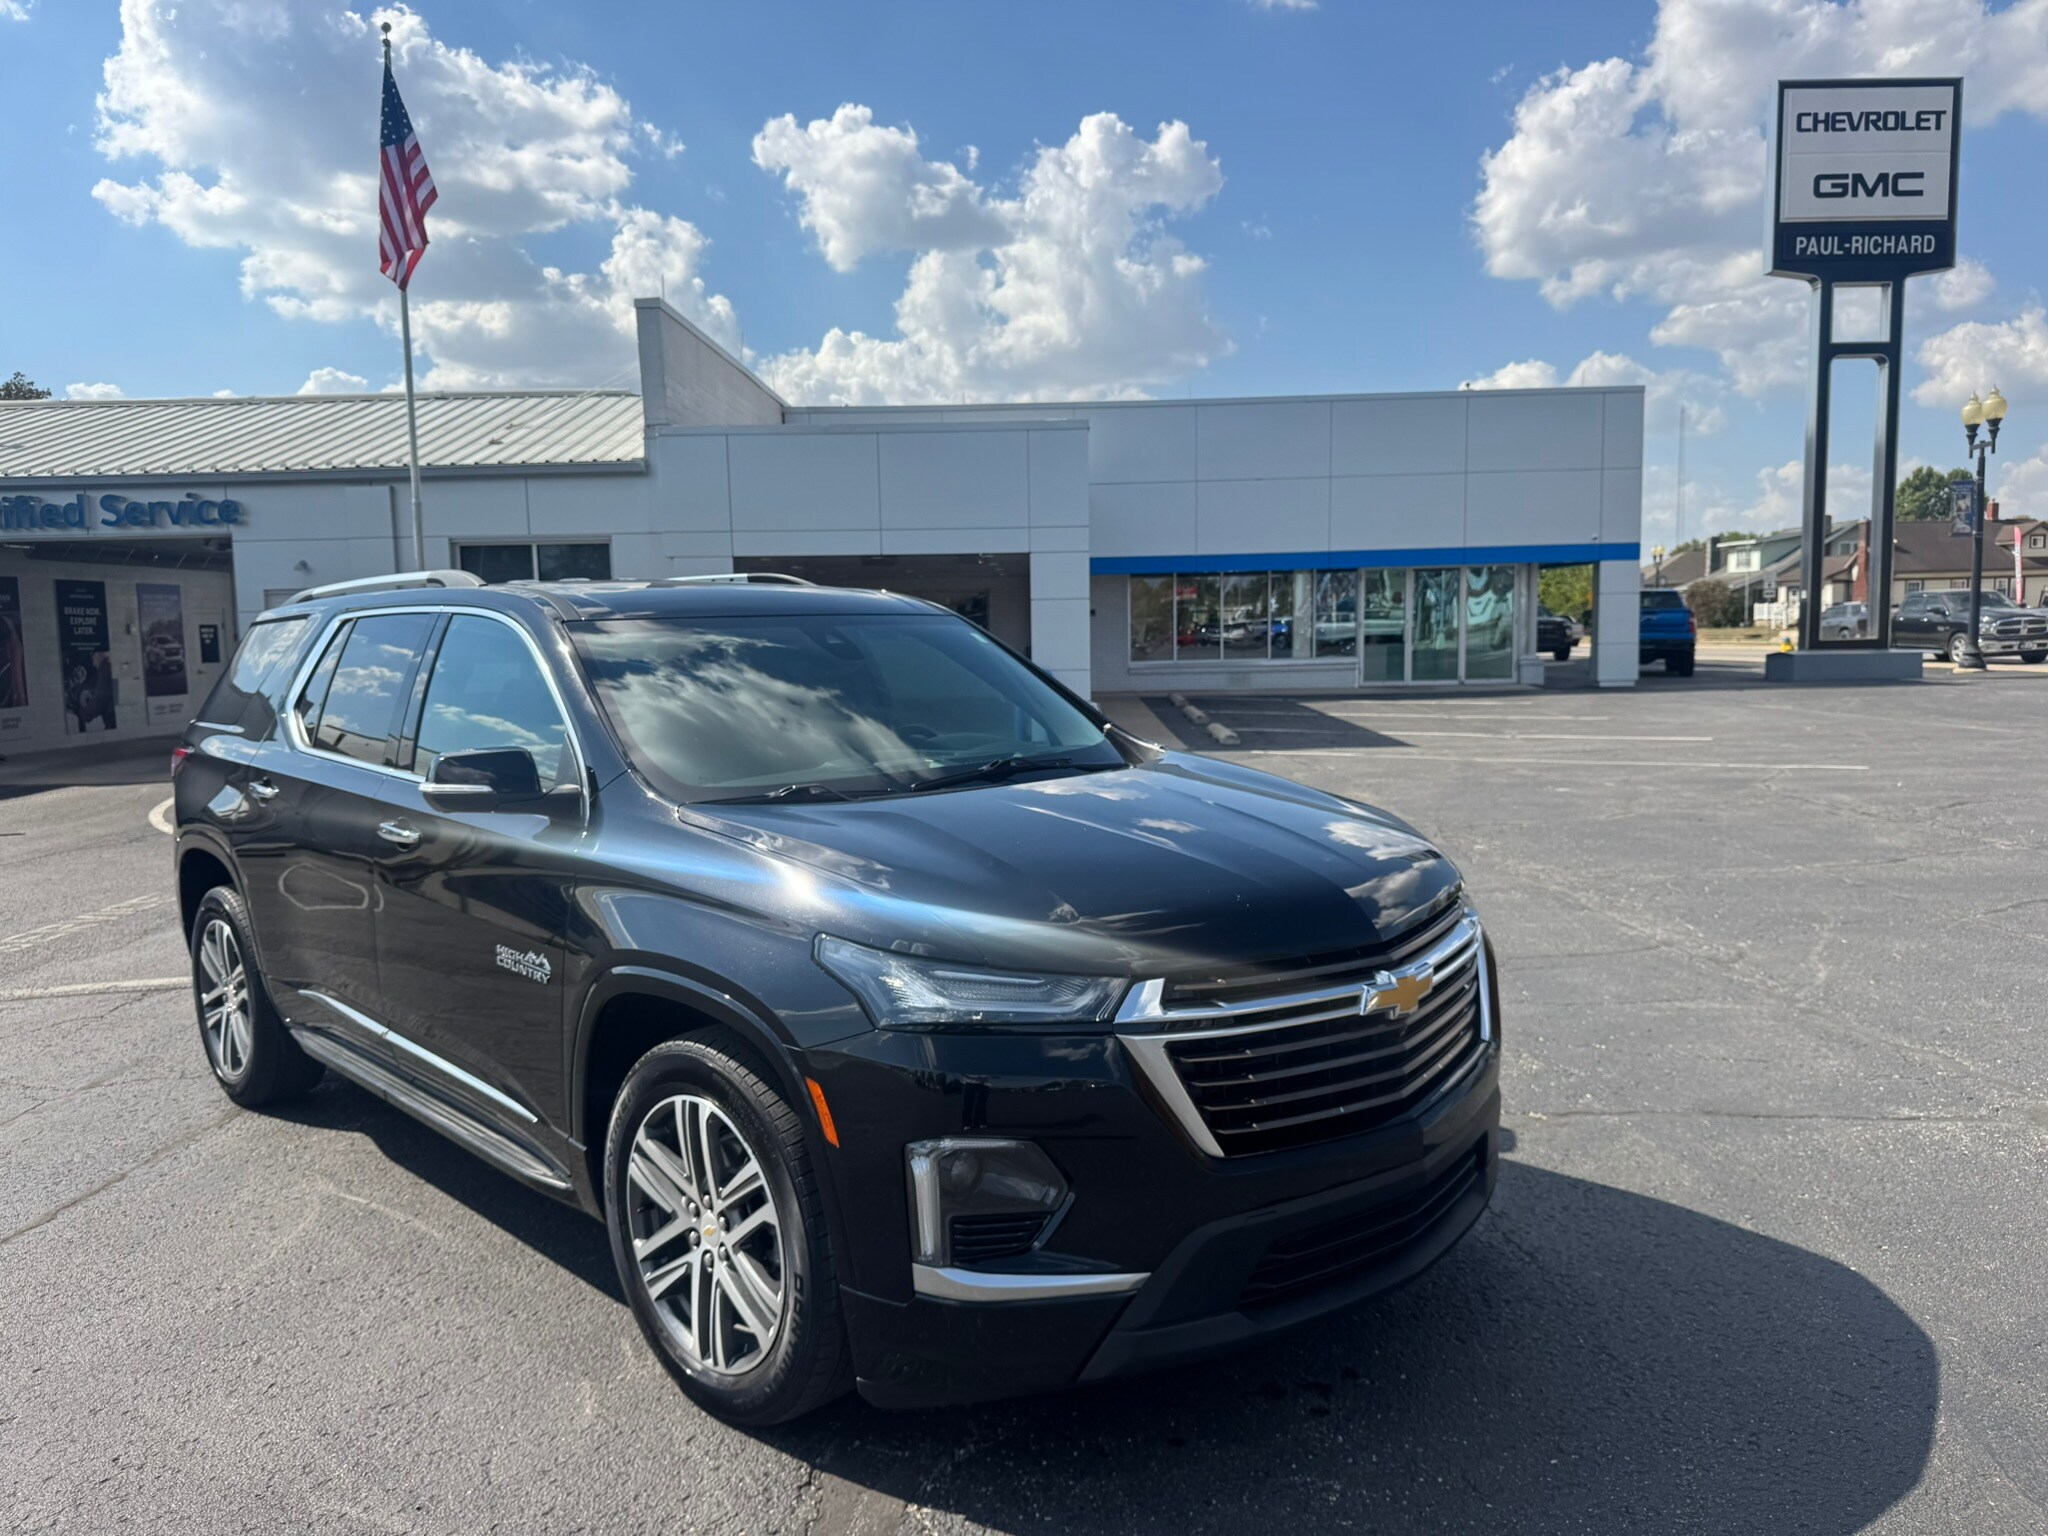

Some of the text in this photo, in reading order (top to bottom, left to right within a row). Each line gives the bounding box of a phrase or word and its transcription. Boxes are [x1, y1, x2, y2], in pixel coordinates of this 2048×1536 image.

[1796, 110, 1947, 132] CHEVROLET
[1813, 172, 1925, 199] GMC
[1795, 235, 1936, 256] PAUL-RICHARD
[0, 491, 244, 528] ified Service
[64, 606, 85, 616] BRAKE
[70, 616, 97, 626] EXPLORE
[496, 944, 525, 962] HIGH
[496, 955, 551, 985] COUNTRY
